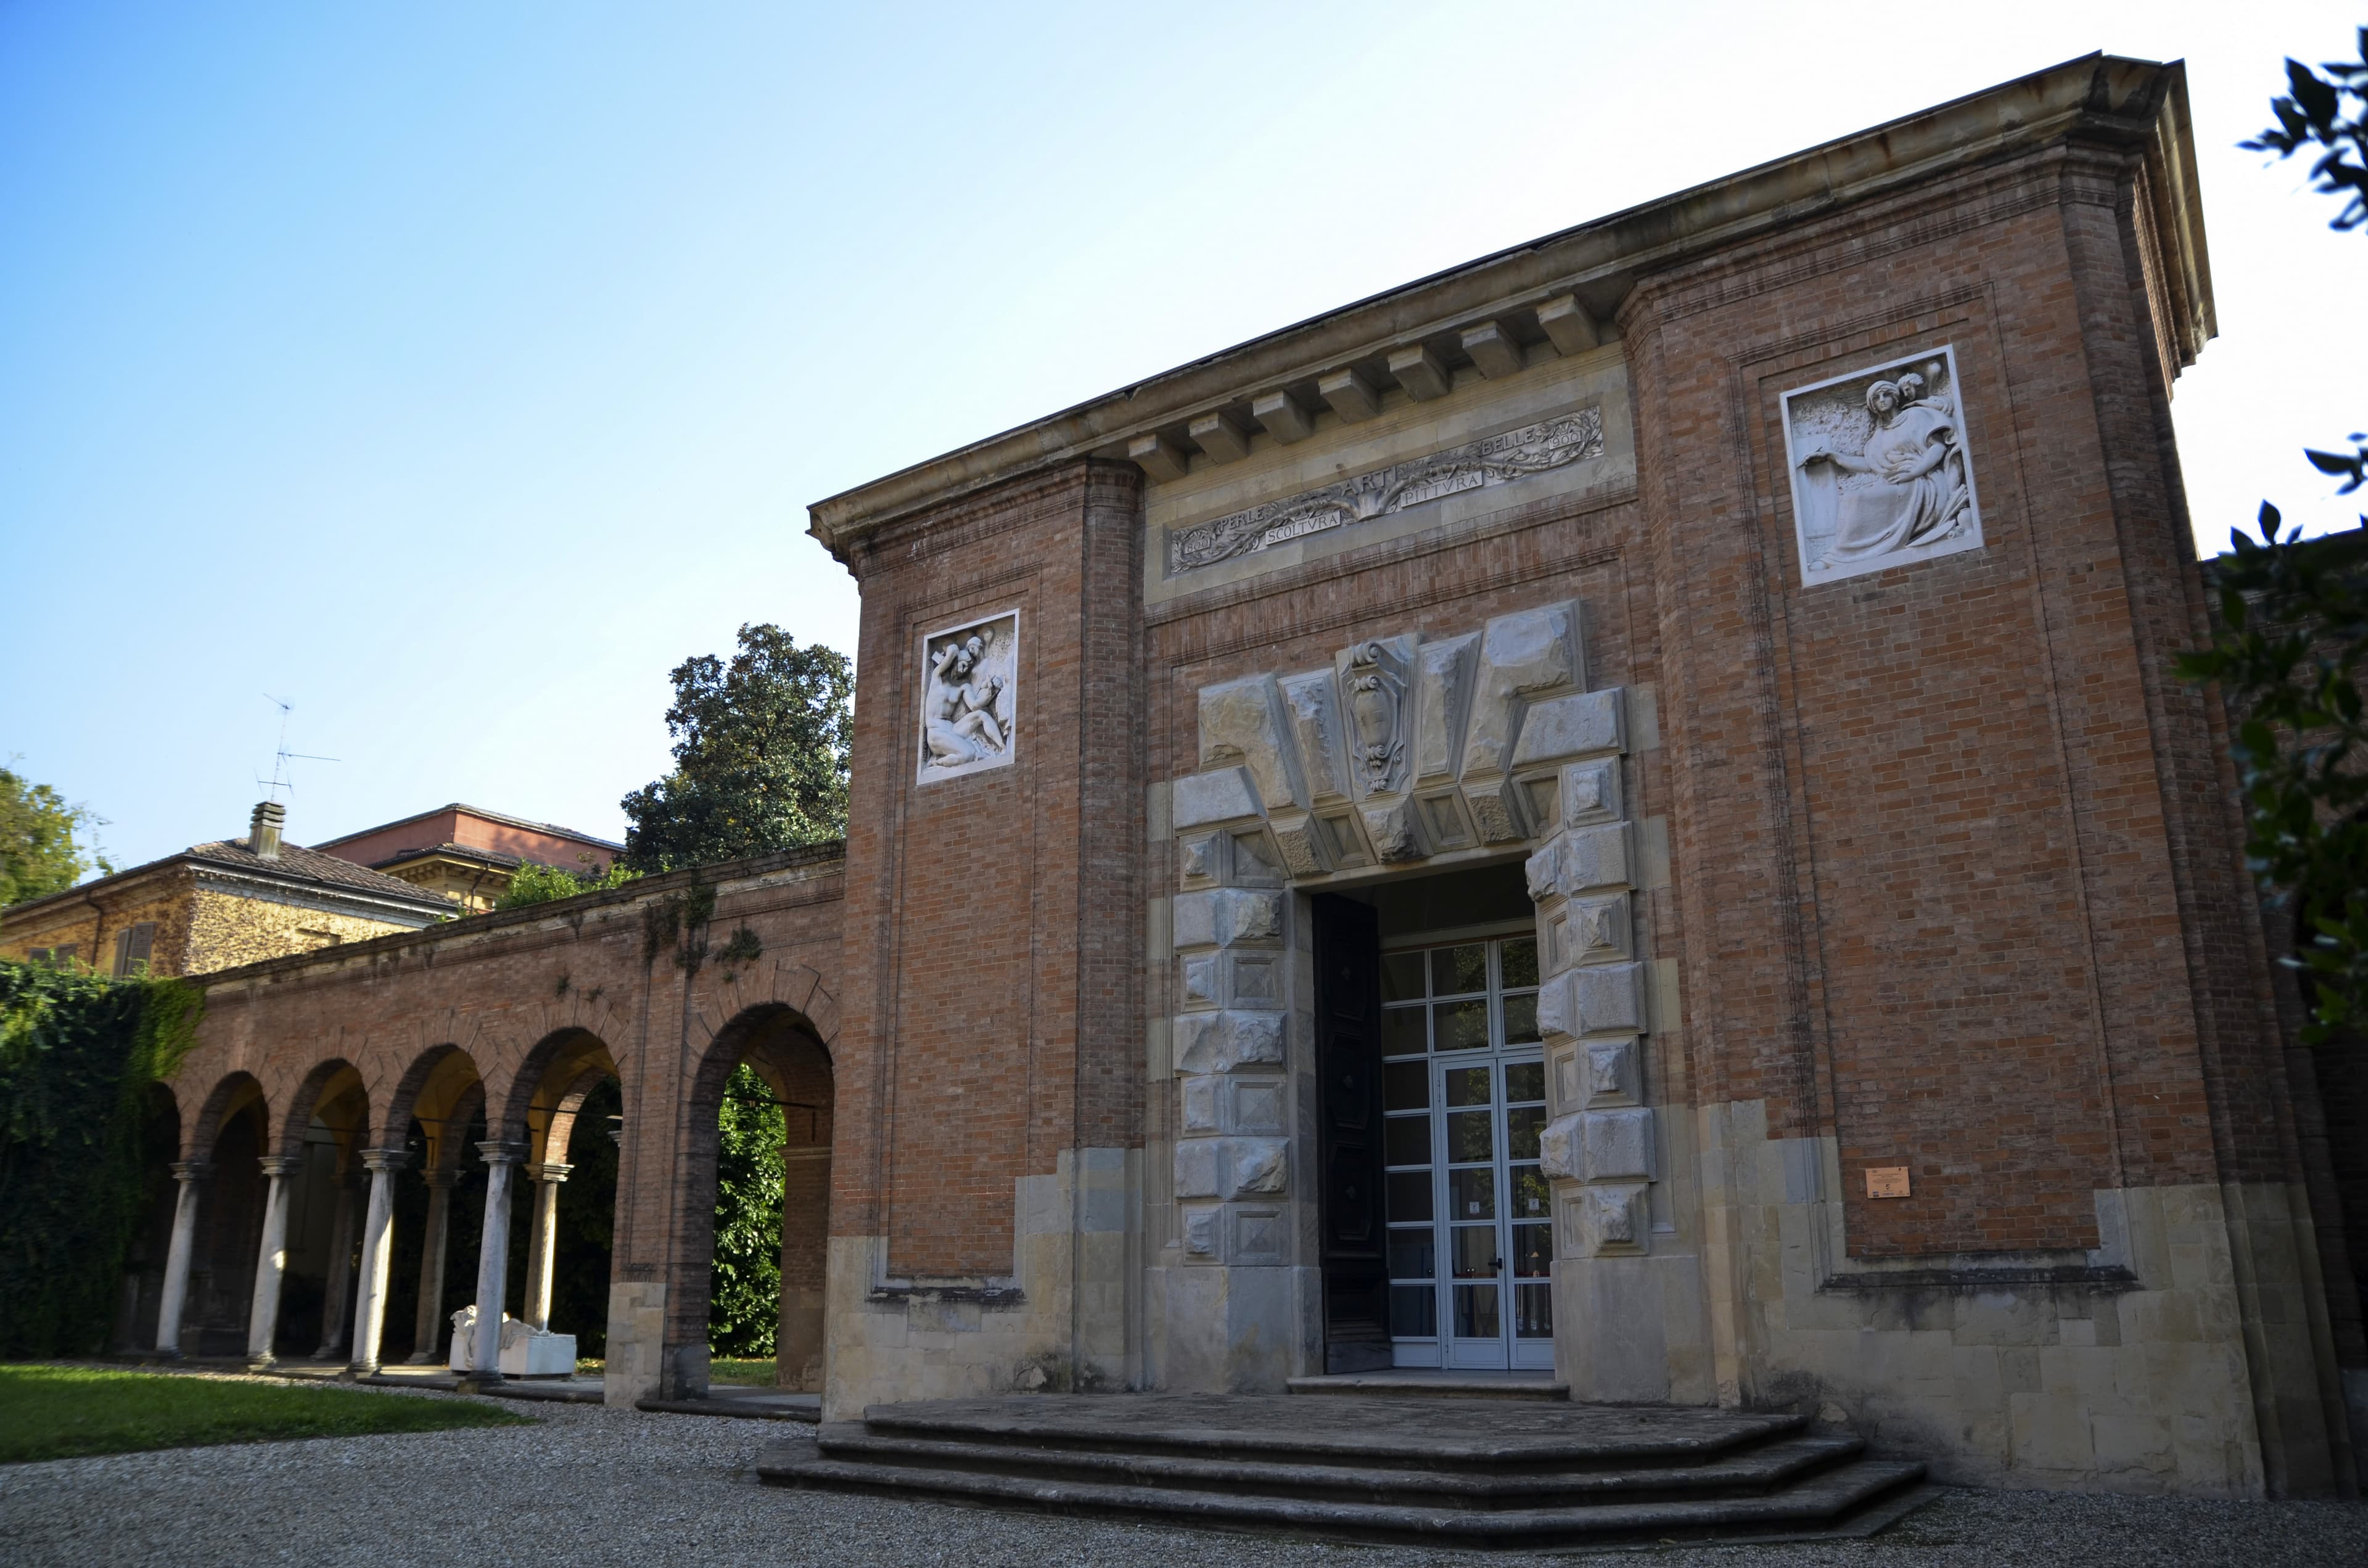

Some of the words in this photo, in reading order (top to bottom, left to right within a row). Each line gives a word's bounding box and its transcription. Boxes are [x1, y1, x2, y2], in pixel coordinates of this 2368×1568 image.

[1341, 466, 1397, 497] ARTI
[1481, 428, 1535, 456] BELLE
[1405, 474, 1478, 504] PITTVRA
[1268, 514, 1338, 542] SCOLTVRA
